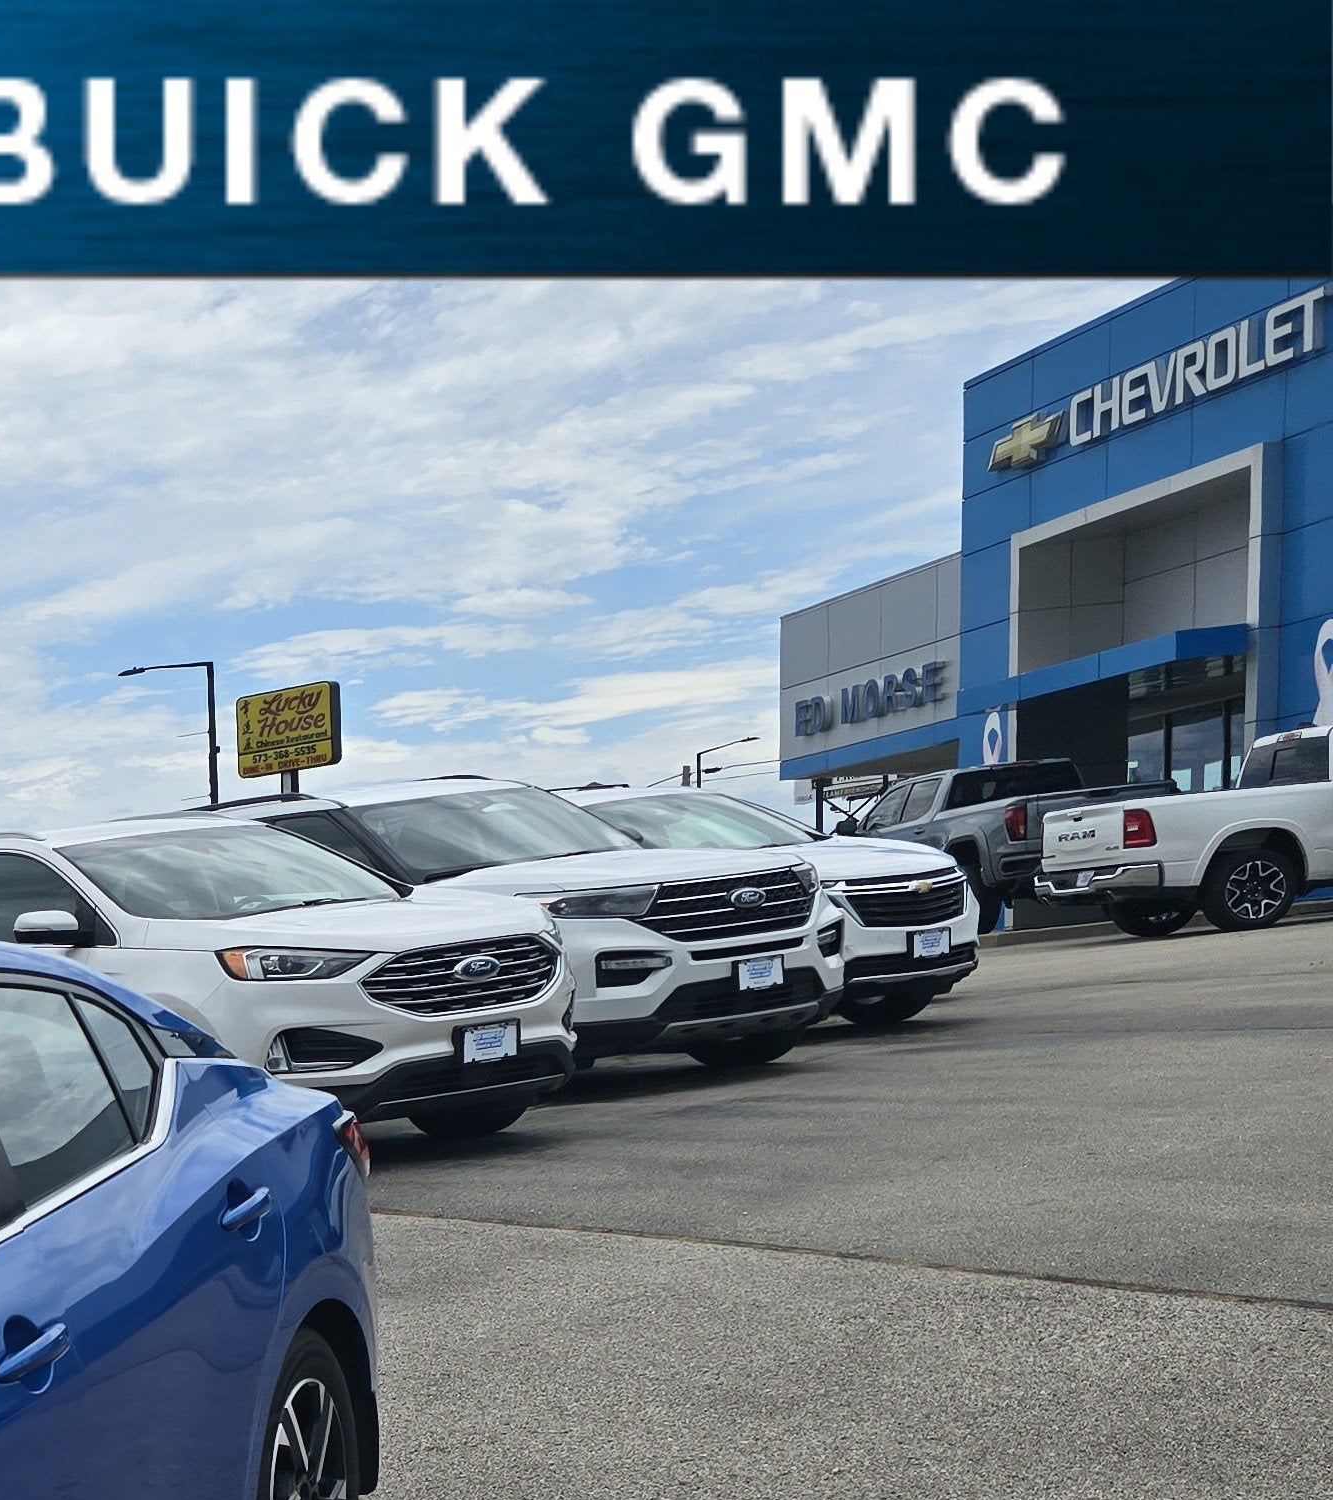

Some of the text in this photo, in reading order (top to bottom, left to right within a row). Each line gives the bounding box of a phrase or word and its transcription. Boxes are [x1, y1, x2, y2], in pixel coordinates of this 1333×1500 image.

[1069, 285, 1325, 447] CHEVROLET
[259, 689, 323, 716] Lucky
[795, 660, 949, 737] ED MORSE
[252, 744, 317, 764] 573-368-5535
[256, 737, 285, 749] Chinese
[1058, 829, 1096, 842] RAM
